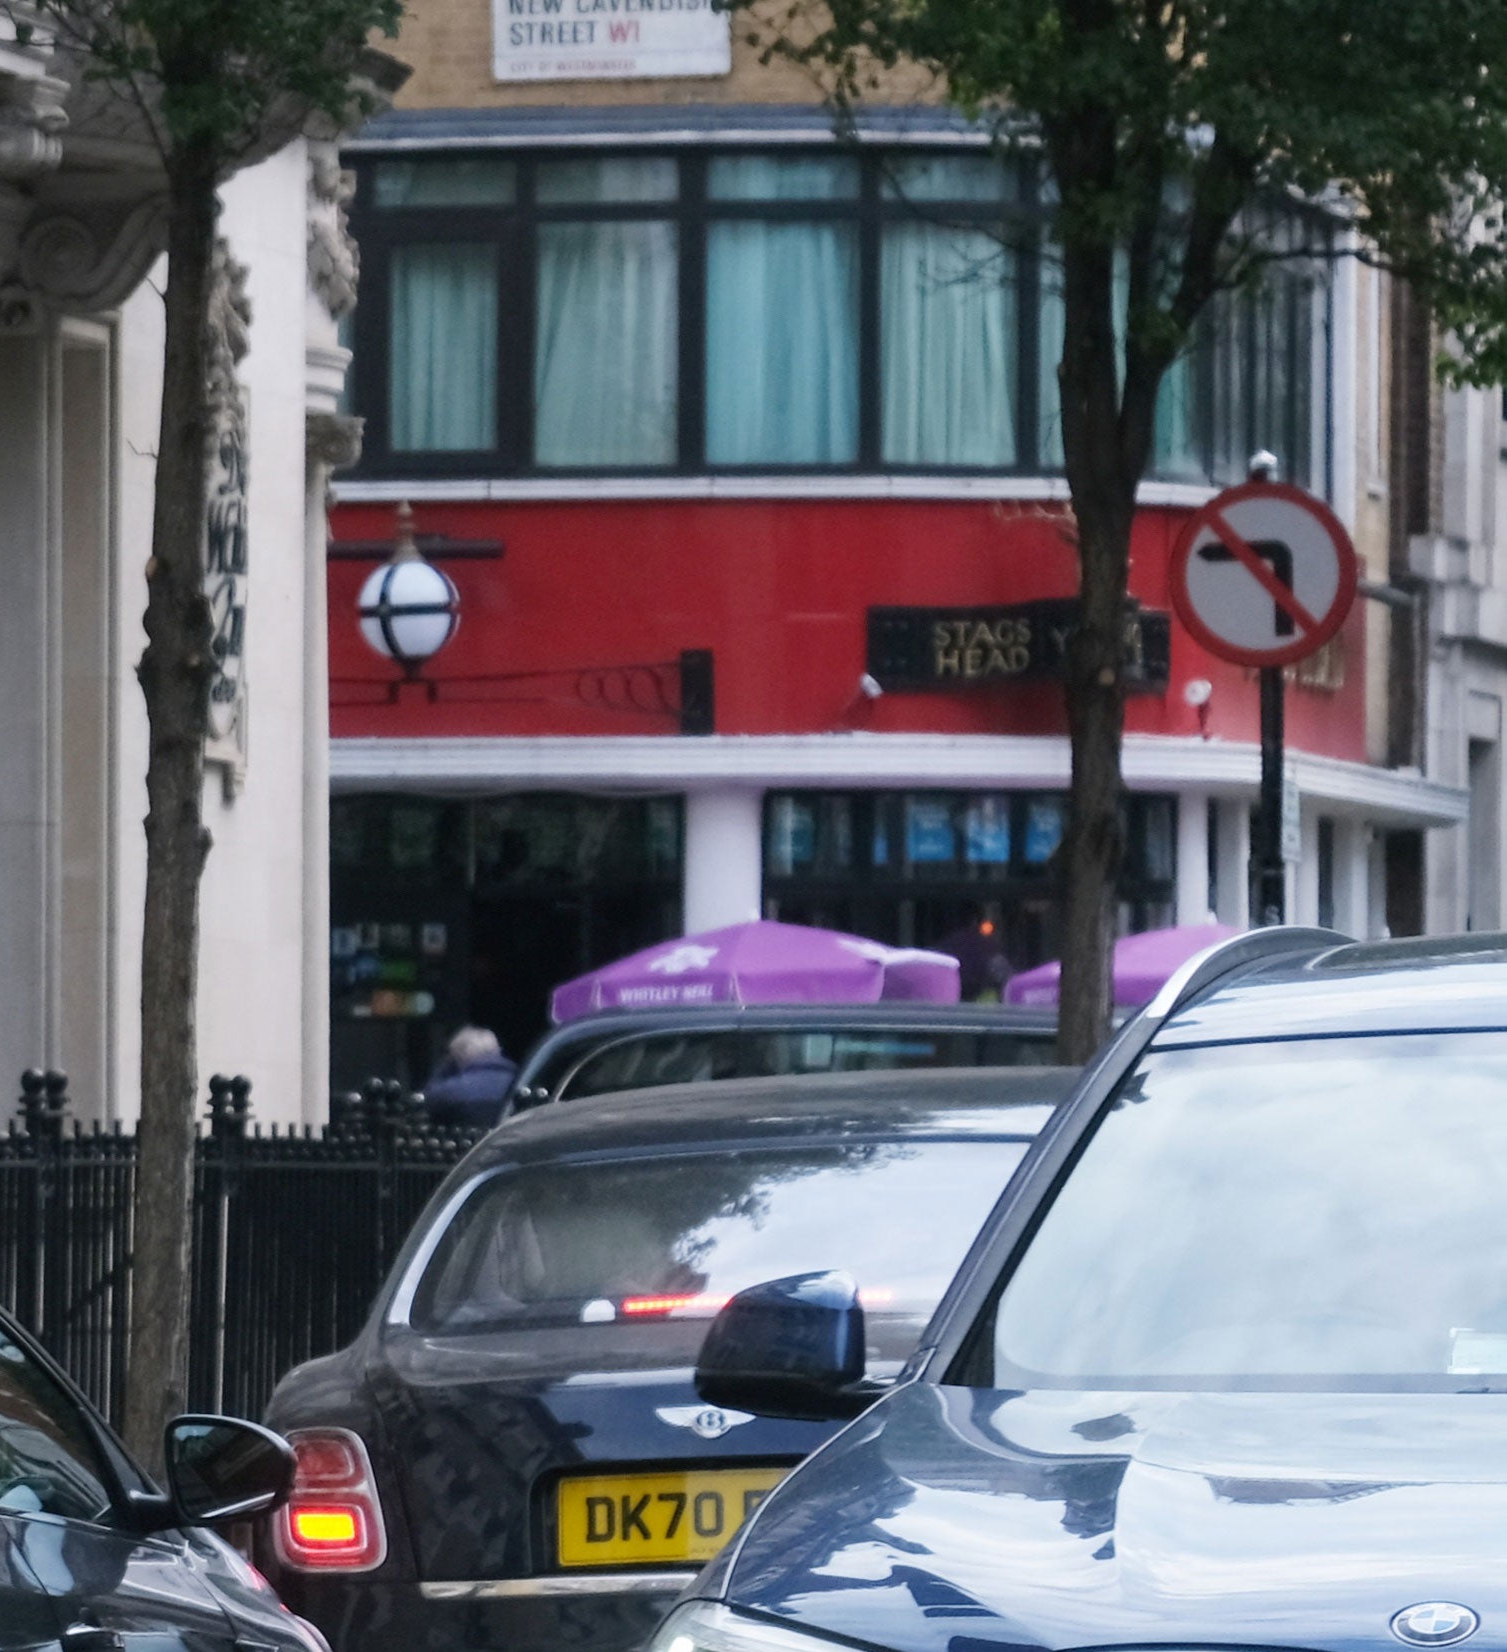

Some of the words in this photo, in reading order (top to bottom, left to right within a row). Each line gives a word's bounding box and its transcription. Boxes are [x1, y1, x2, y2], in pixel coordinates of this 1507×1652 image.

[510, 20, 599, 45] STREET
[609, 19, 639, 43] W1
[933, 617, 1031, 648] STAGS
[935, 647, 1031, 678] HEAD
[584, 1492, 725, 1543] DK70
